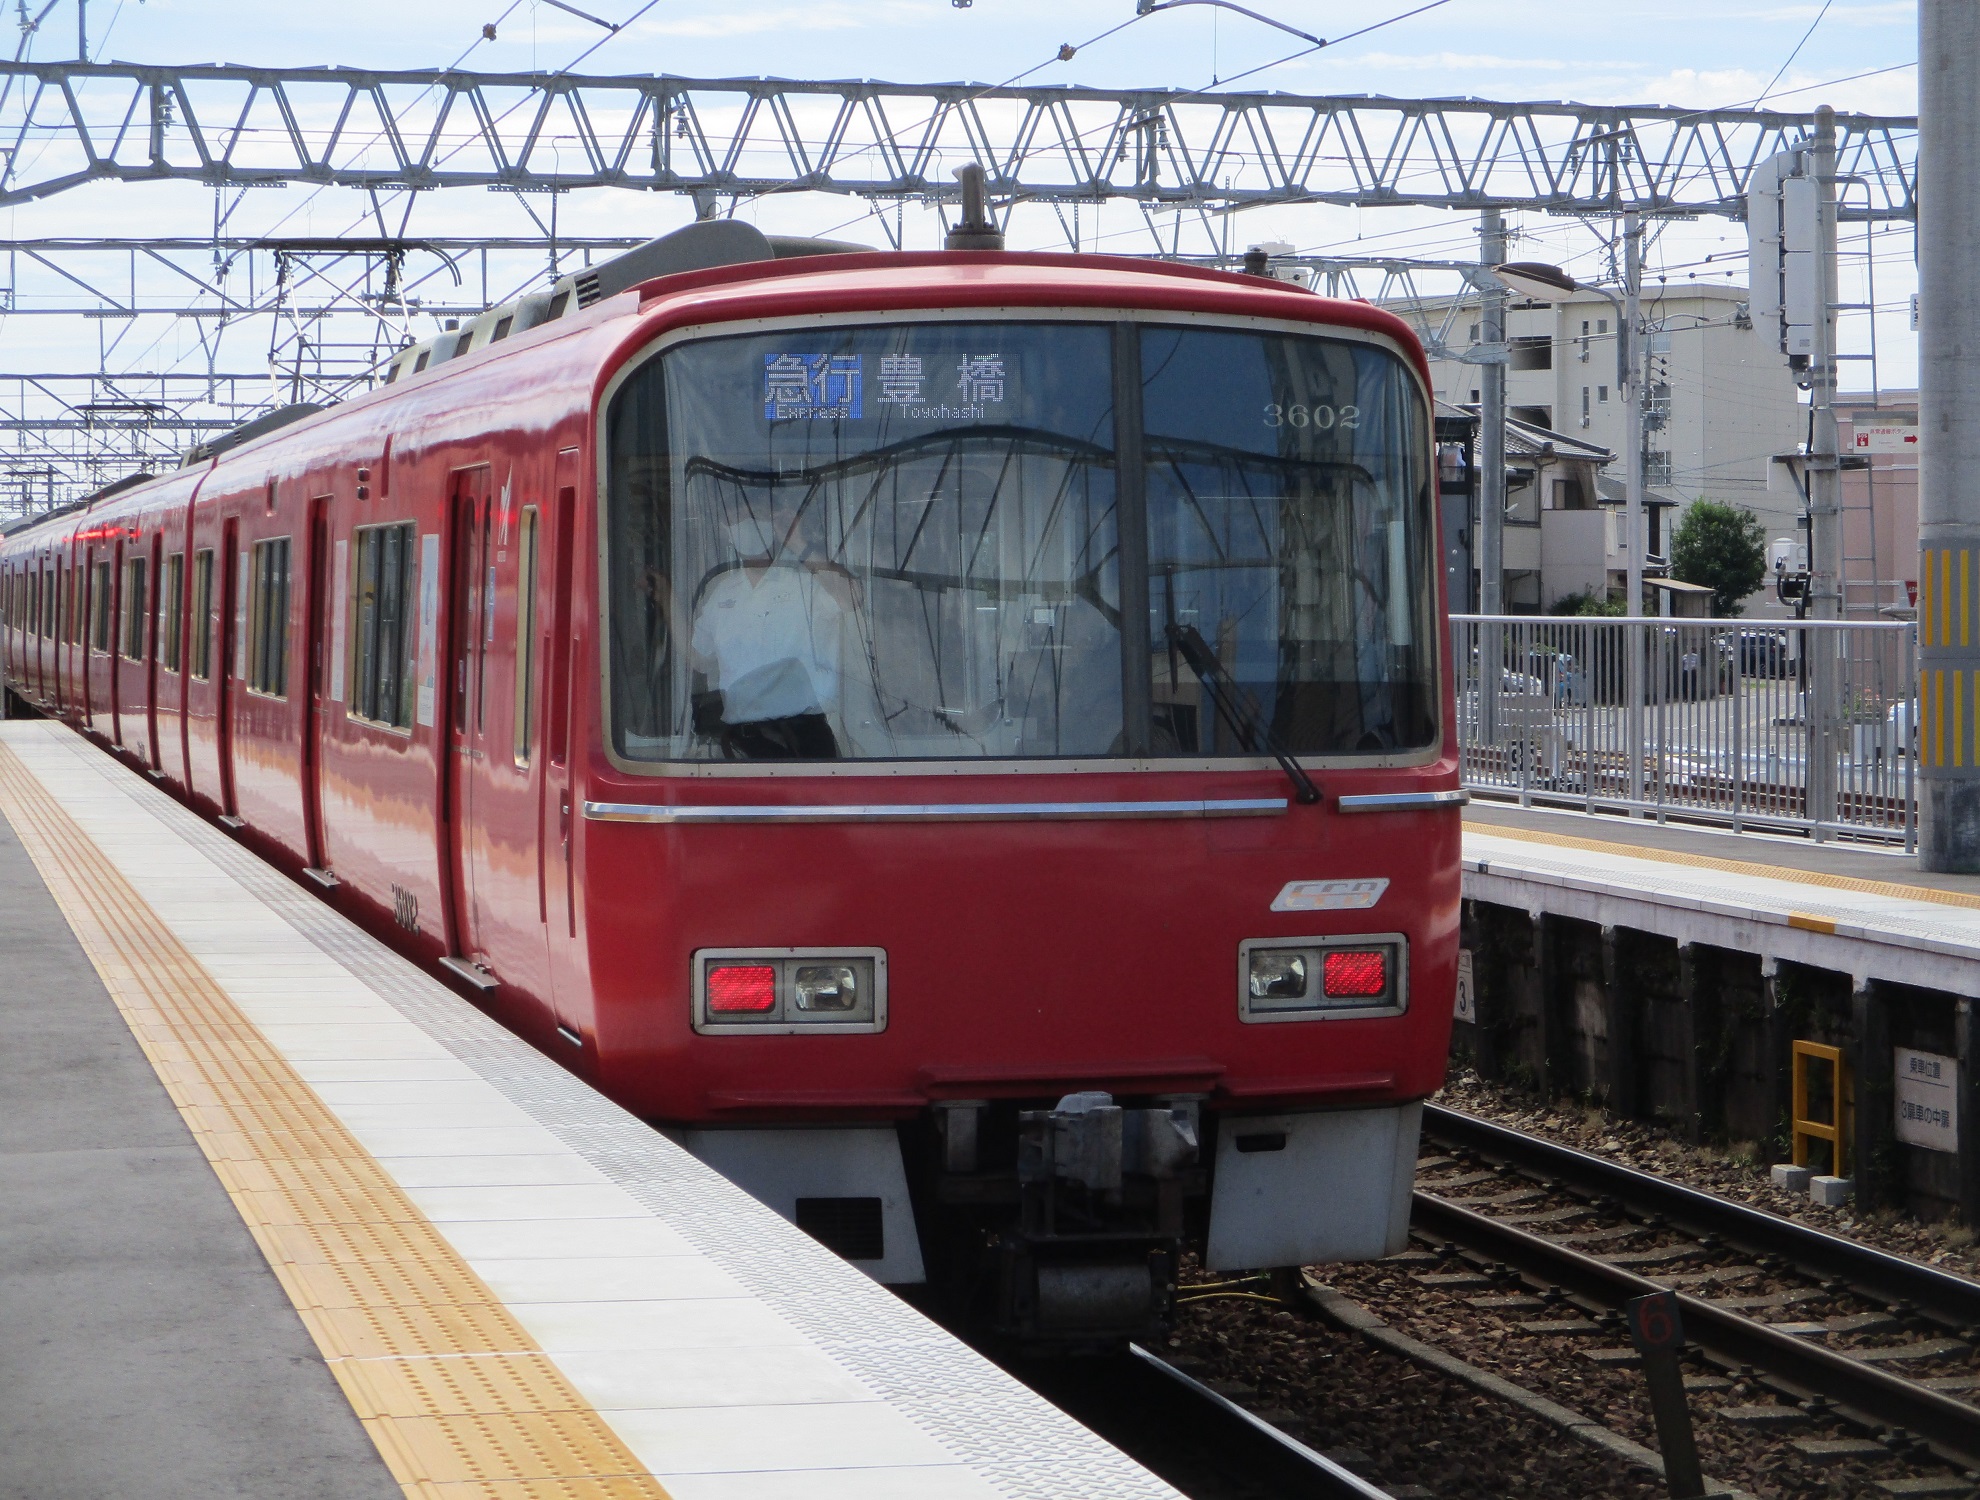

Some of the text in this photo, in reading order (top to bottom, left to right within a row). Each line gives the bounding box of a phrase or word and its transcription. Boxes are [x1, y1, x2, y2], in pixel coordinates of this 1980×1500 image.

[765, 354, 860, 402] 急行
[777, 404, 984, 418] Express Toyohashi
[1263, 404, 1360, 428] 3602
[1910, 1057, 1941, 1079] 乗車位置
[1902, 1100, 1950, 1128] 3扉車の中扉
[1639, 1296, 1673, 1344] 6
